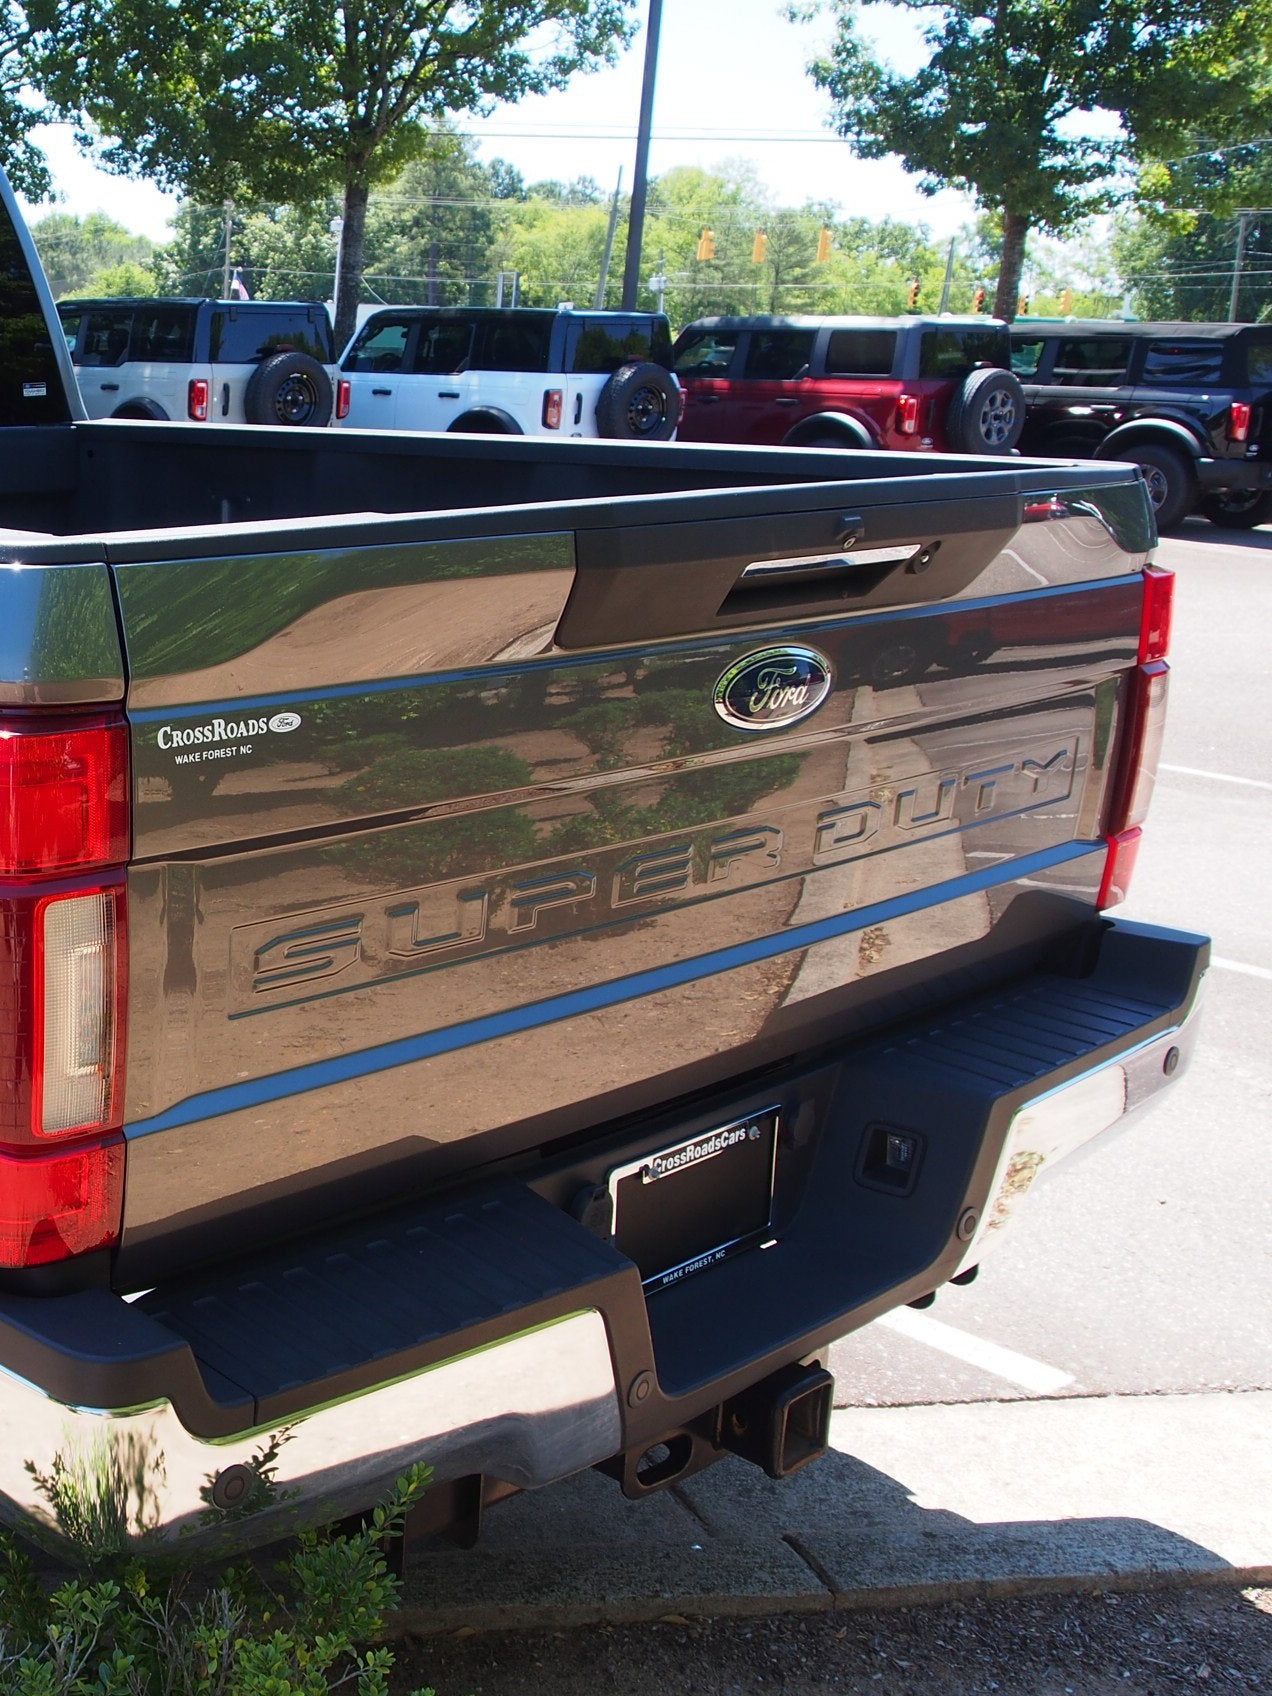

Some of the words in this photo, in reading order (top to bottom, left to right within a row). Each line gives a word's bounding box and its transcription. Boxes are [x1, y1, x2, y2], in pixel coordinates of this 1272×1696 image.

[749, 665, 812, 713] Ford
[174, 752, 202, 766] WAKE
[202, 746, 238, 761] FOREST
[239, 744, 253, 755] NC
[253, 826, 784, 994] SUPER
[813, 749, 1073, 858] DUTY
[662, 1268, 684, 1285] WAKE
[715, 1249, 727, 1260] NC
